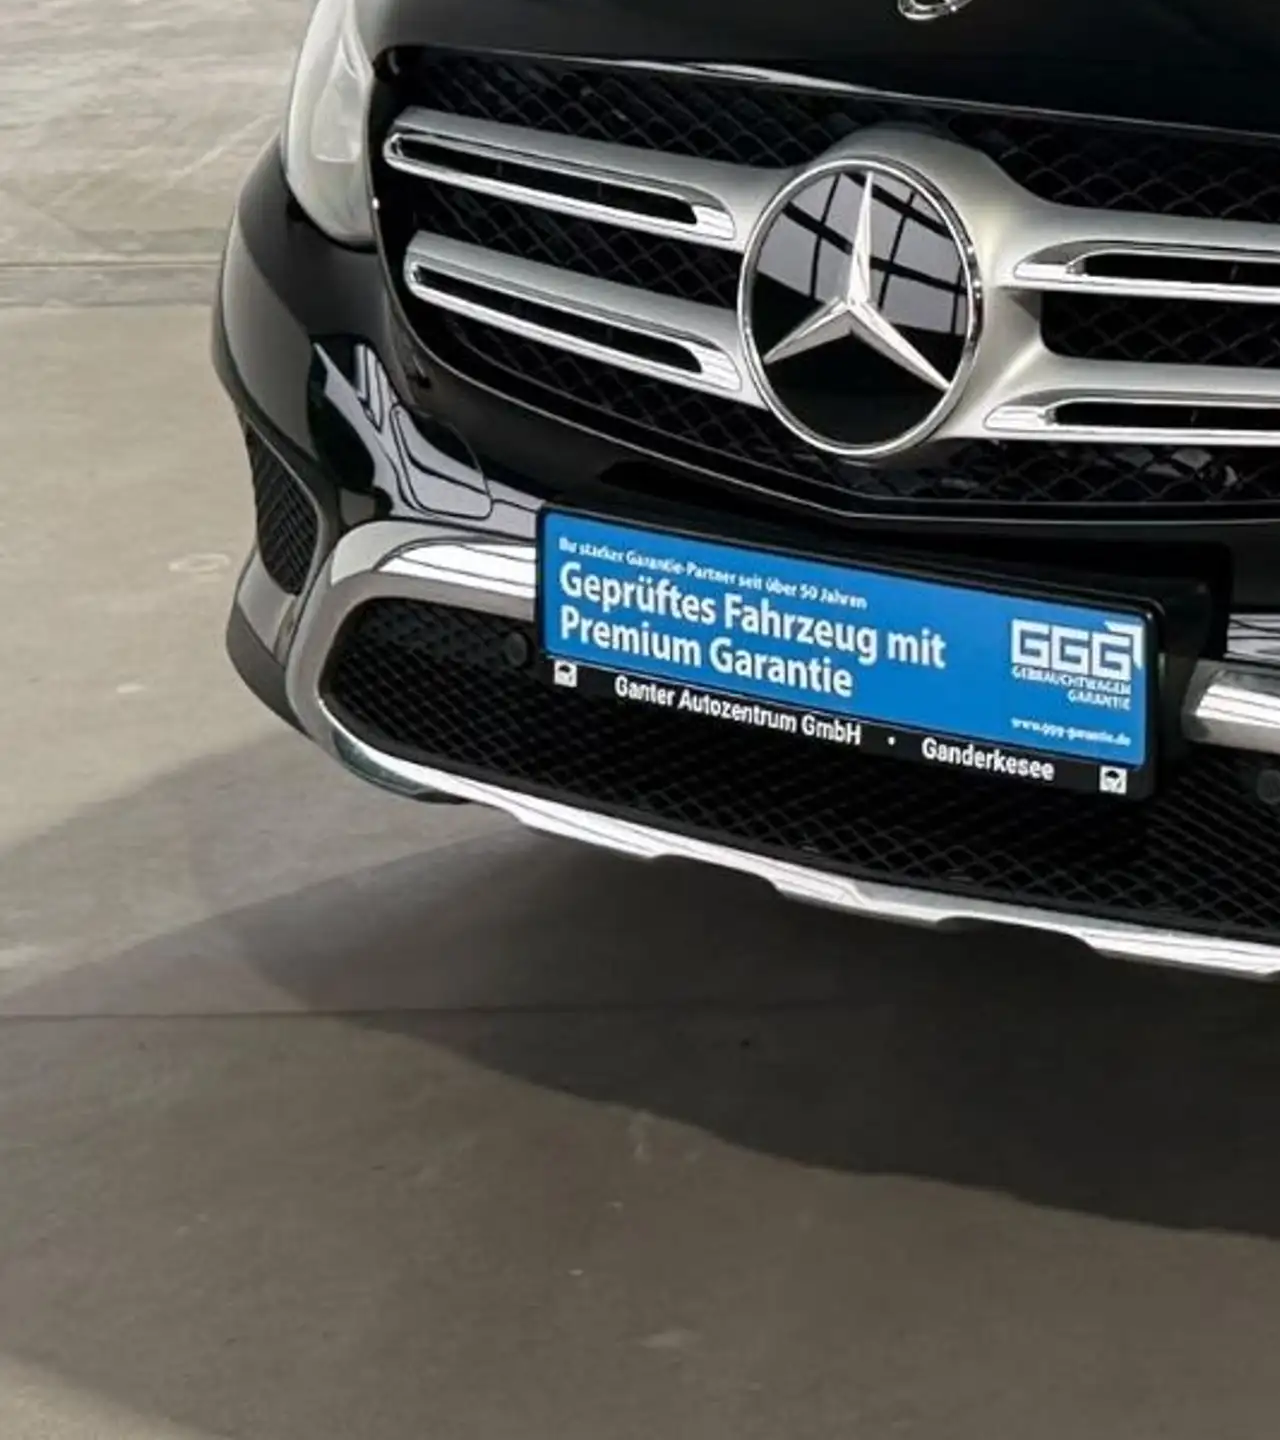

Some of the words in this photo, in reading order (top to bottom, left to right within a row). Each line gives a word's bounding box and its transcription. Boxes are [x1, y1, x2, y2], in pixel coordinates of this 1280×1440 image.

[559, 561, 716, 626] Geprüftes
[724, 592, 878, 665] Fahrzeug
[888, 628, 946, 669] mit
[738, 574, 762, 590] seit
[765, 577, 798, 598] über
[819, 588, 868, 610] Jahren
[561, 604, 702, 669] Premium
[709, 637, 854, 698] Garantie
[1011, 618, 1140, 681] GGG
[614, 674, 674, 707] Ganter
[678, 688, 798, 734] Autozentrum
[801, 715, 862, 746] GmbH
[921, 736, 1055, 781] Ganderkesee
